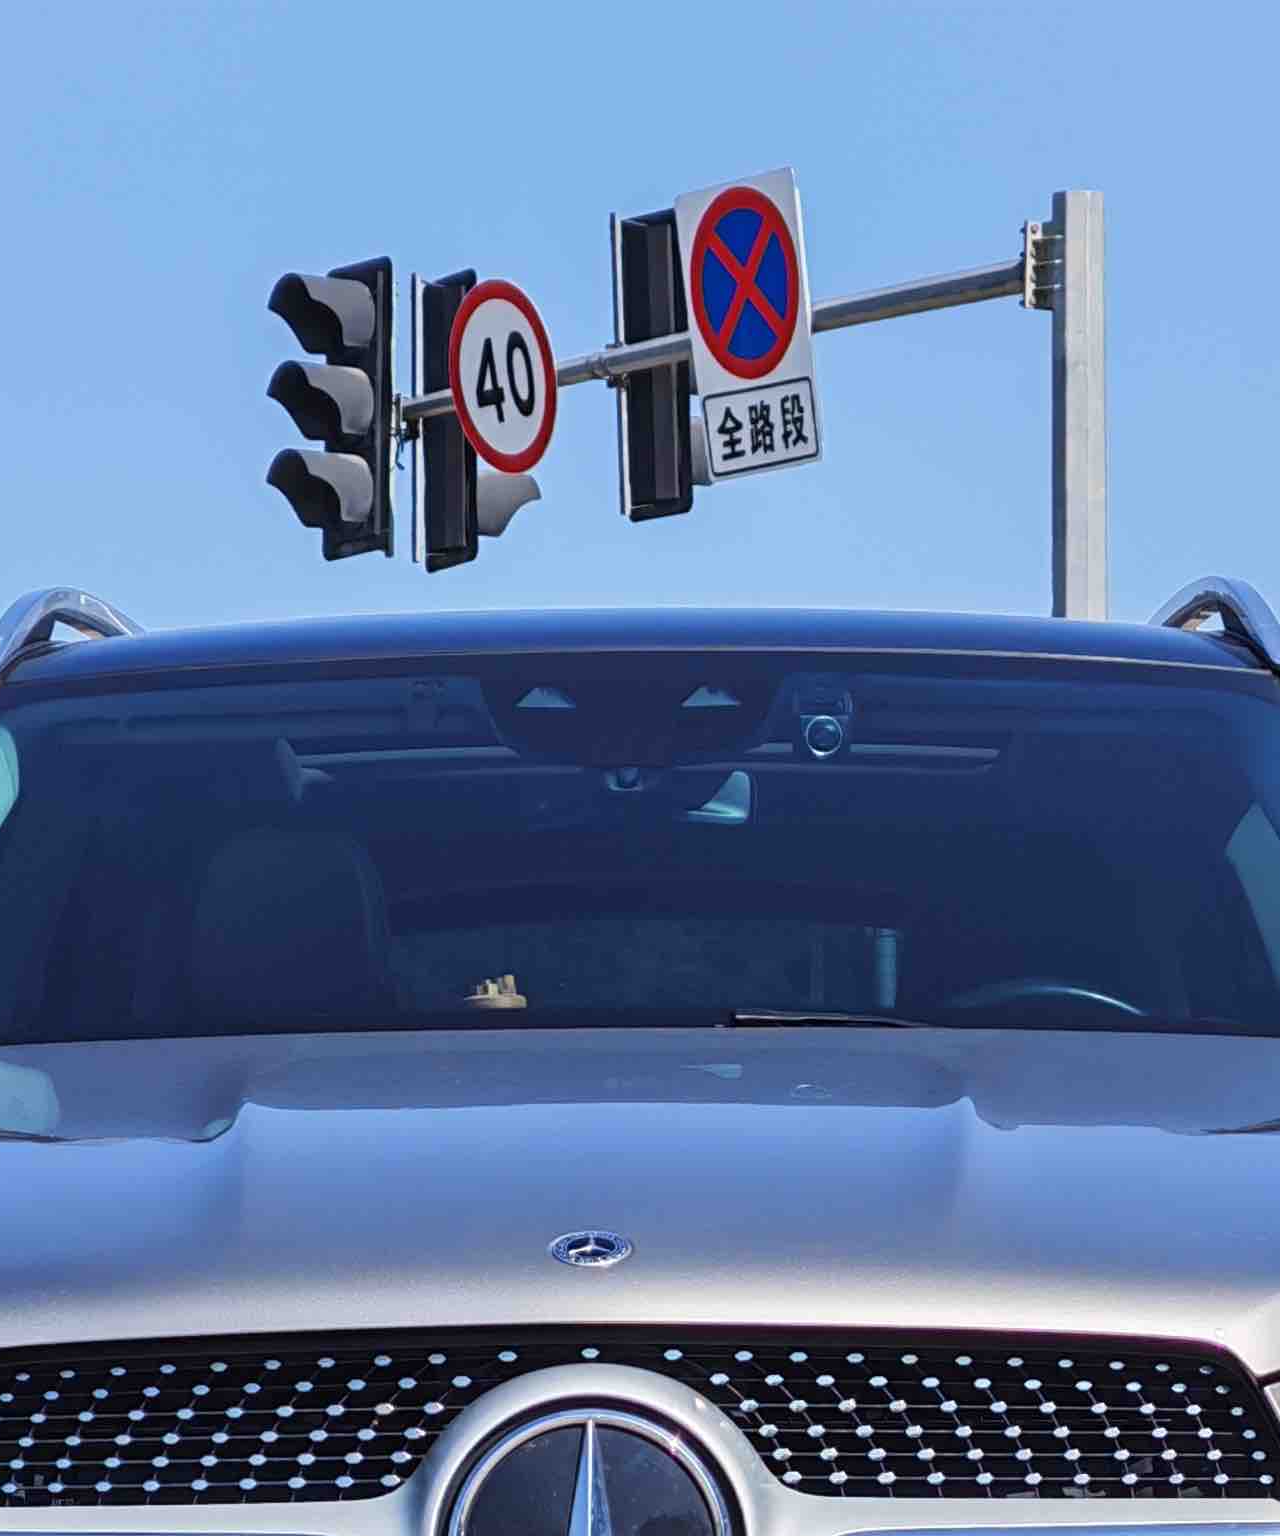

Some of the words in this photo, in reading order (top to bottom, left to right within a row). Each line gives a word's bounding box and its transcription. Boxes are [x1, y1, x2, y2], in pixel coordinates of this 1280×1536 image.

[475, 330, 536, 424] 40
[716, 394, 809, 459] 全路段
